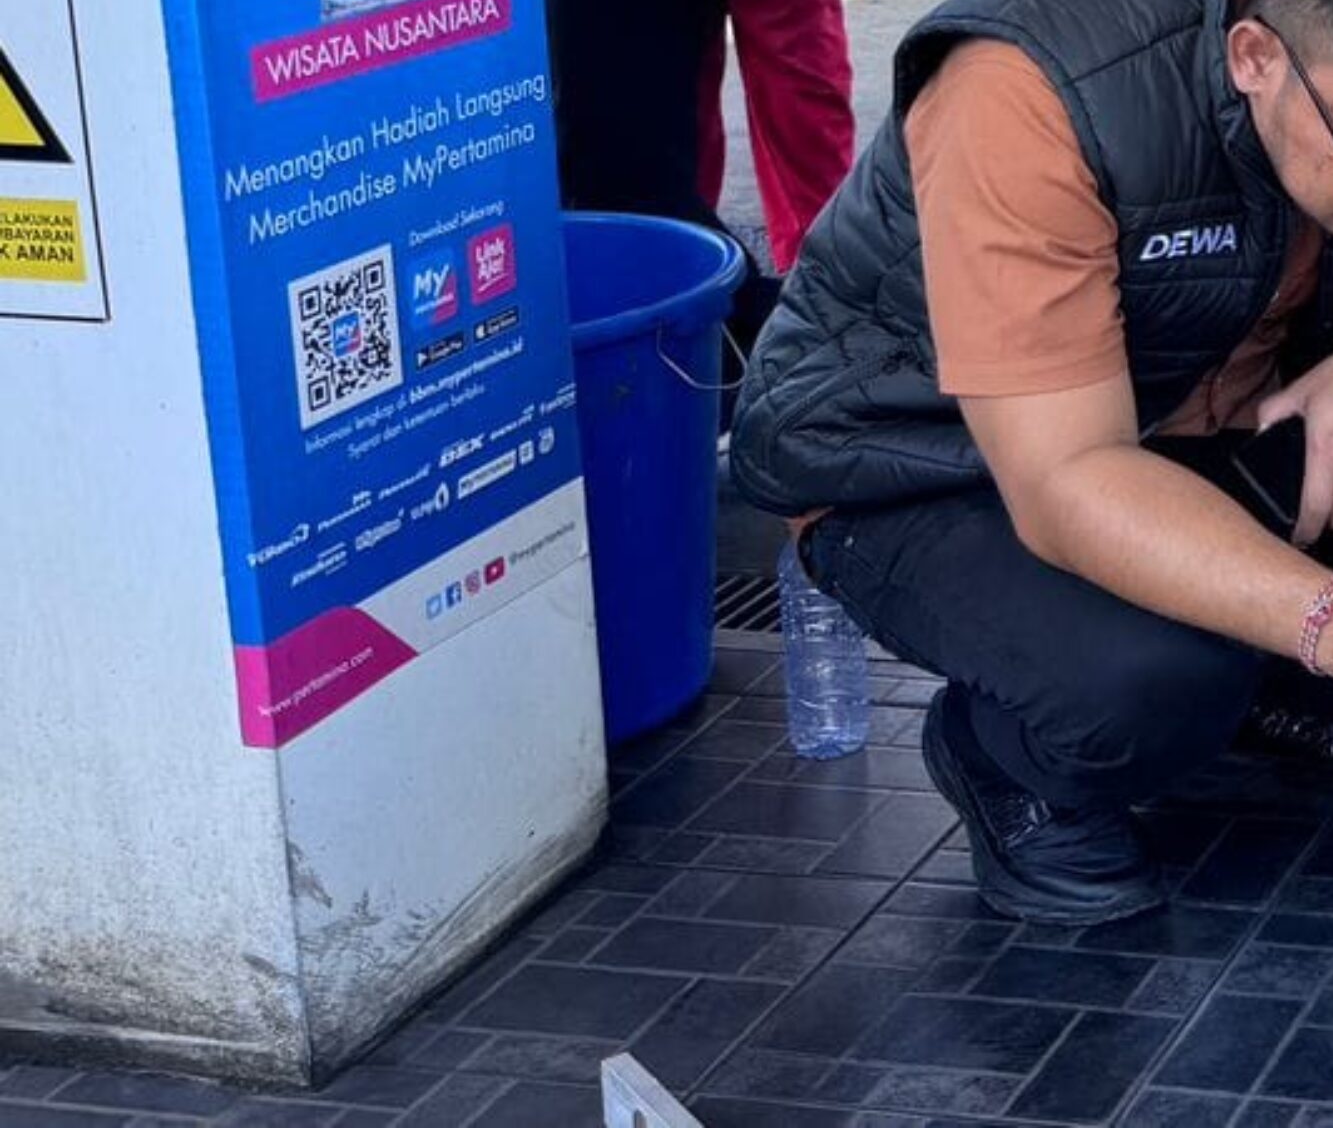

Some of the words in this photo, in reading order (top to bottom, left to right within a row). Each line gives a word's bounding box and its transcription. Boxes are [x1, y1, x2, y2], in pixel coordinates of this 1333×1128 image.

[265, 35, 359, 85] WISATA
[224, 135, 365, 202] Menangkan
[371, 96, 449, 149] Hadiah
[456, 73, 546, 121] Langsung
[249, 171, 397, 245] Merchandise
[403, 122, 535, 189] MyPertamina
[17, 245, 74, 262] AMAN
[1140, 223, 1238, 261] DEWA
